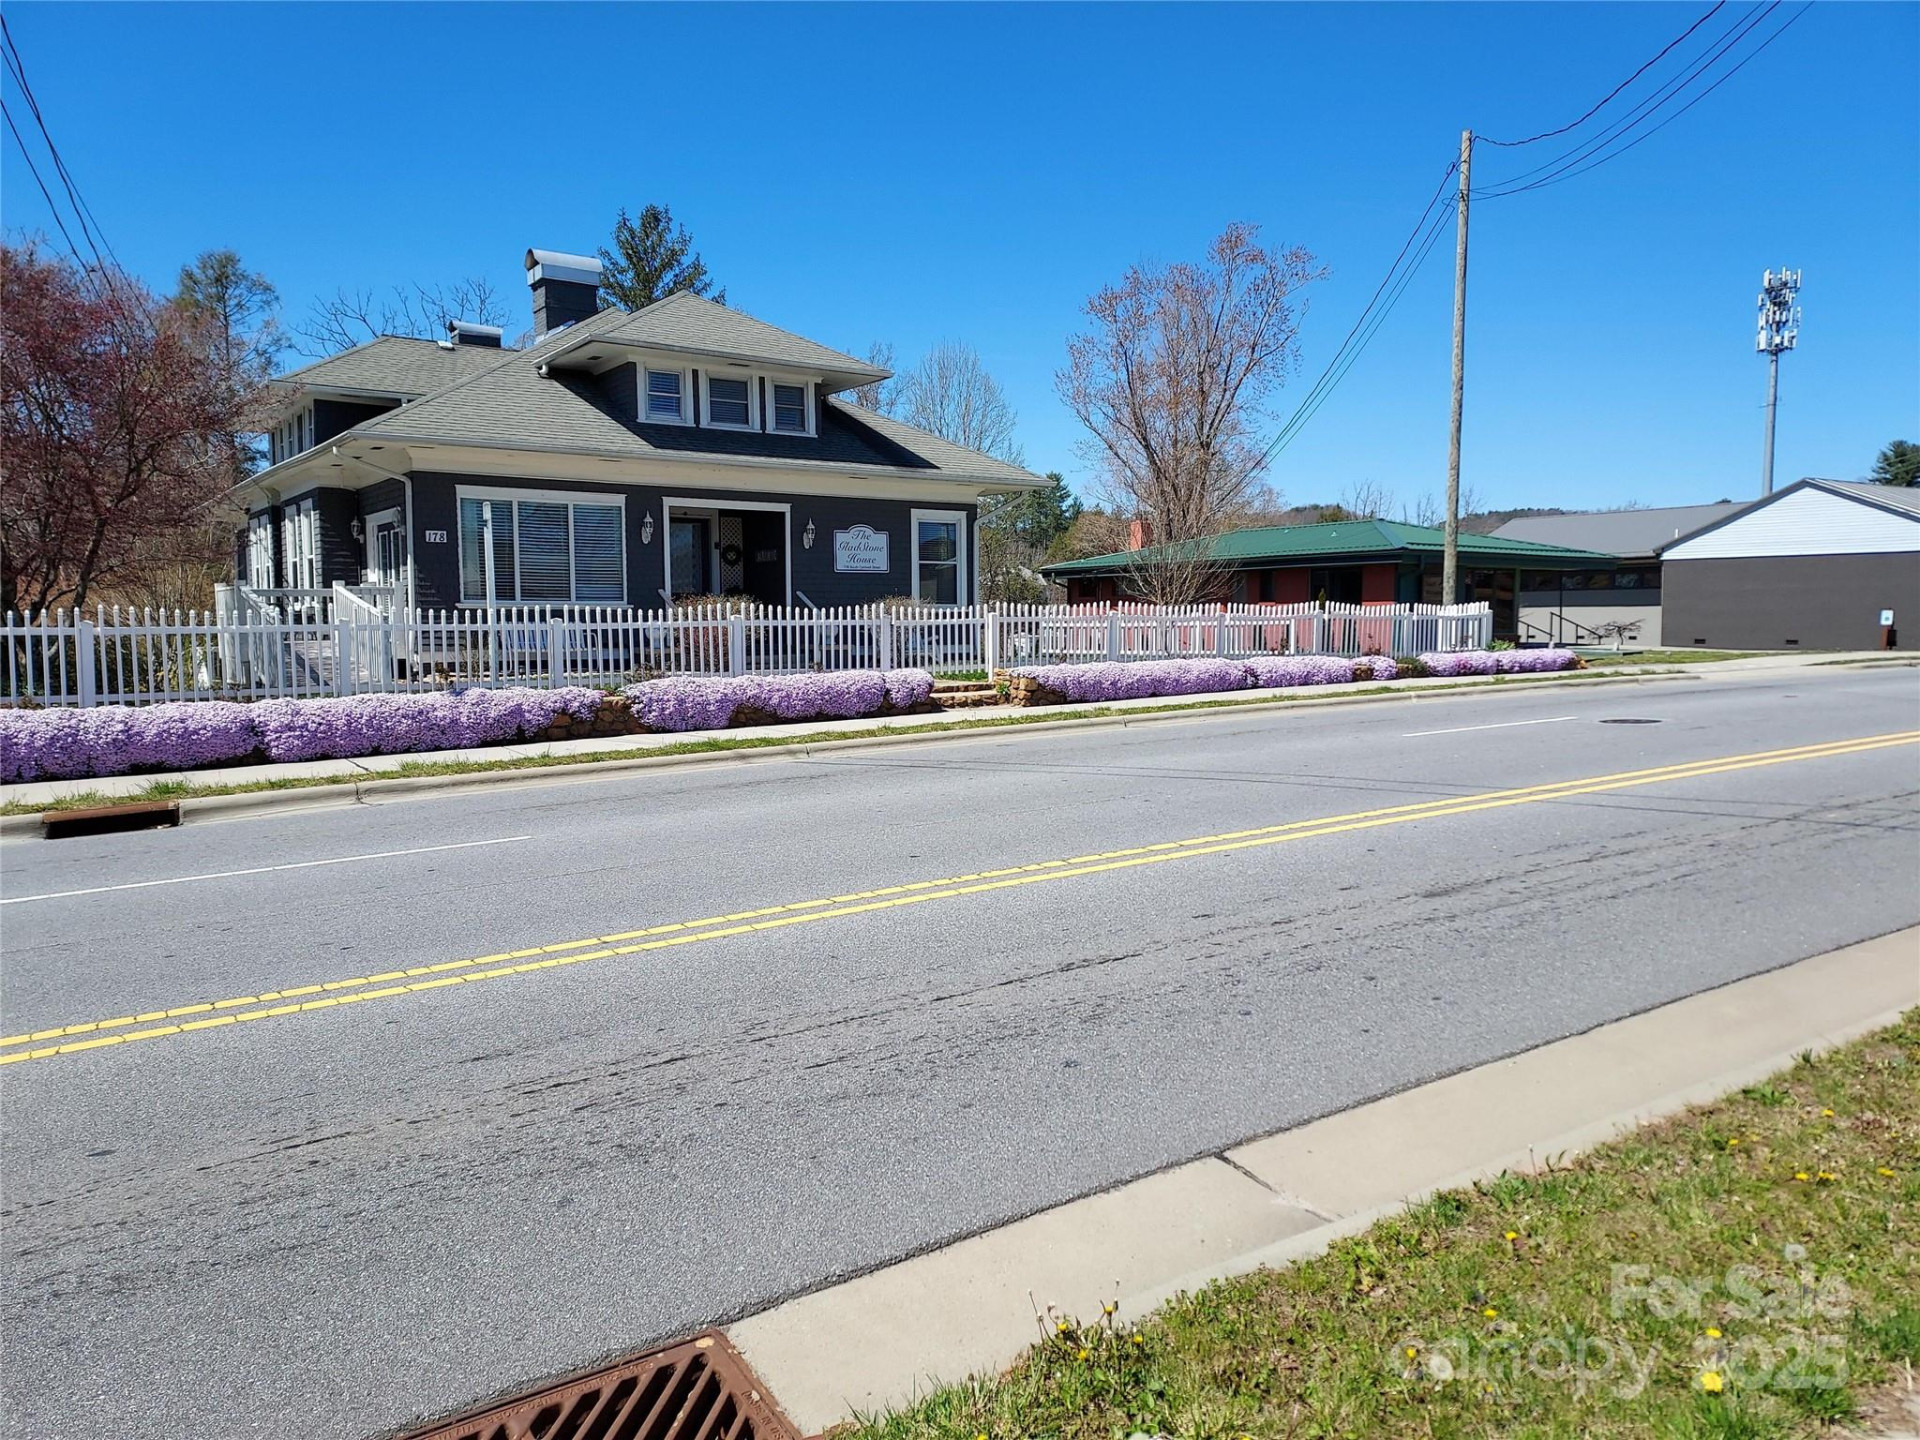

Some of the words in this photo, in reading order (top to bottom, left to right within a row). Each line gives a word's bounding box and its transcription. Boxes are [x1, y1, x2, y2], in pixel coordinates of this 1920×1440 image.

[428, 532, 445, 541] 178
[851, 529, 872, 540] The
[838, 540, 884, 552] GladStone
[846, 553, 877, 564] House
